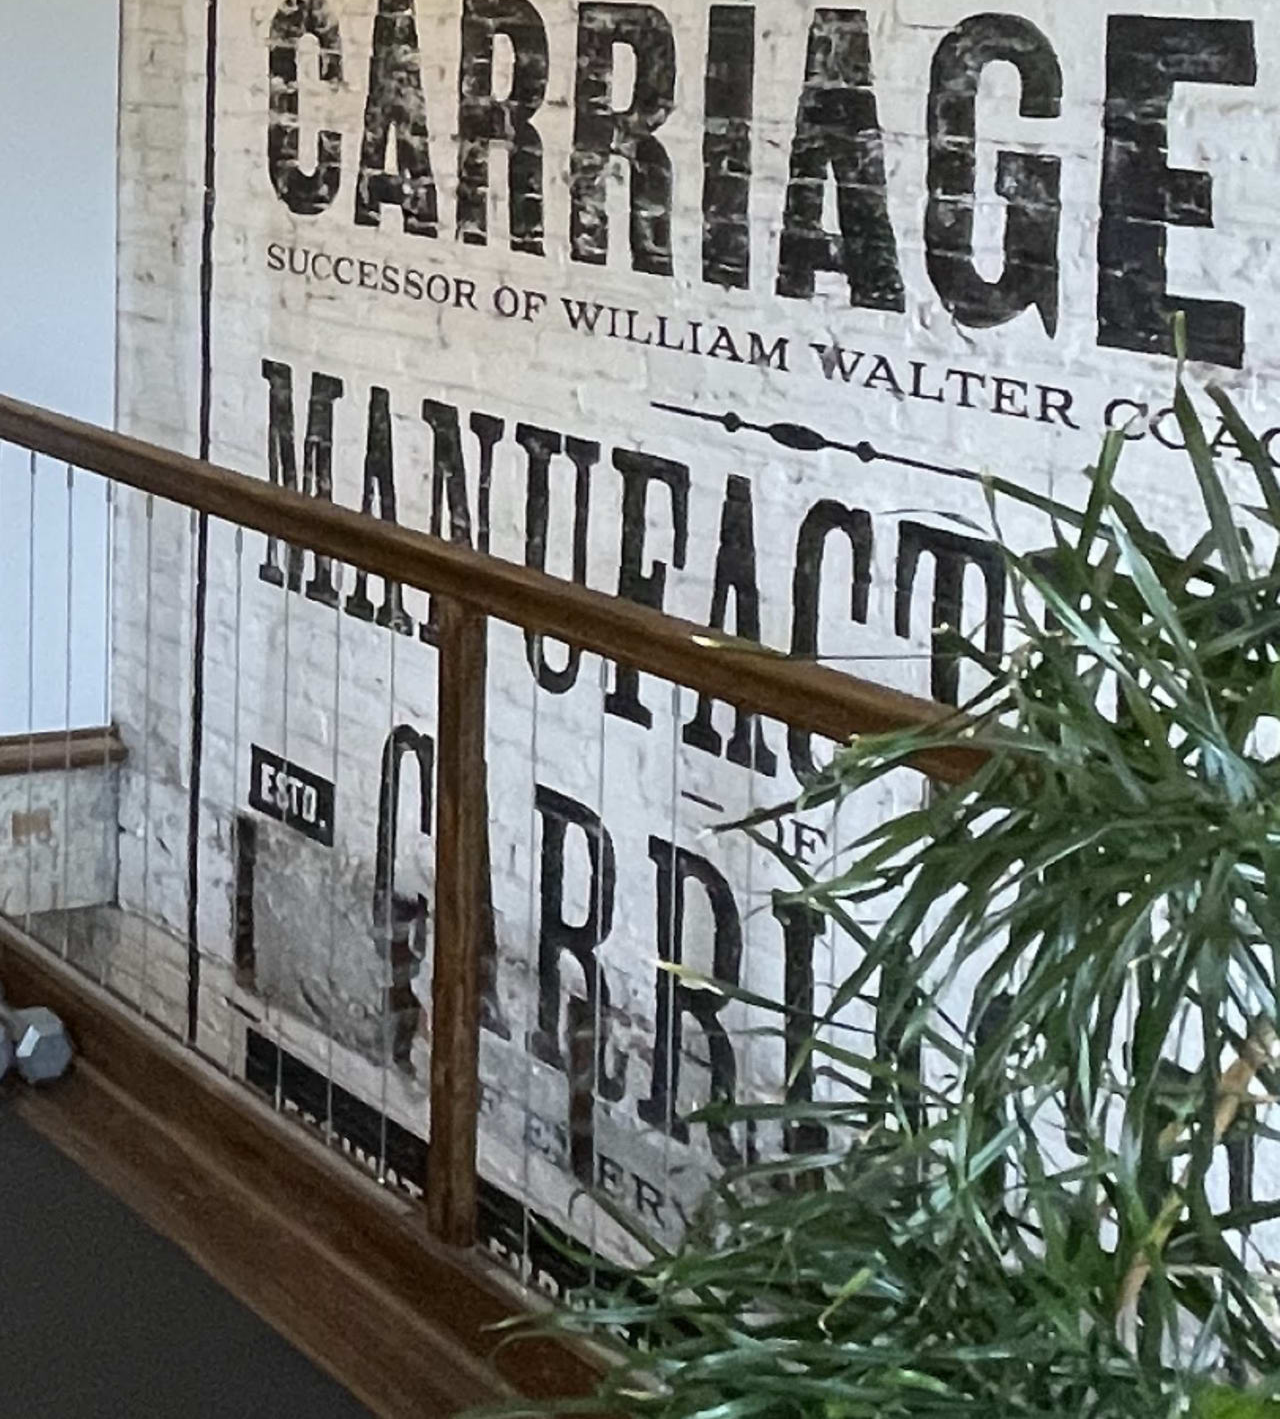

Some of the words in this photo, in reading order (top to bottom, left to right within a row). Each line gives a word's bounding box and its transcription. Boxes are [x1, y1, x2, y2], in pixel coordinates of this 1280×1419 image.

[266, 242, 478, 311] SUCCESSOR
[492, 284, 548, 323] OF
[559, 296, 791, 373] WILLIAM
[808, 342, 1081, 431] WALTER
[260, 762, 327, 829] ESTD.
